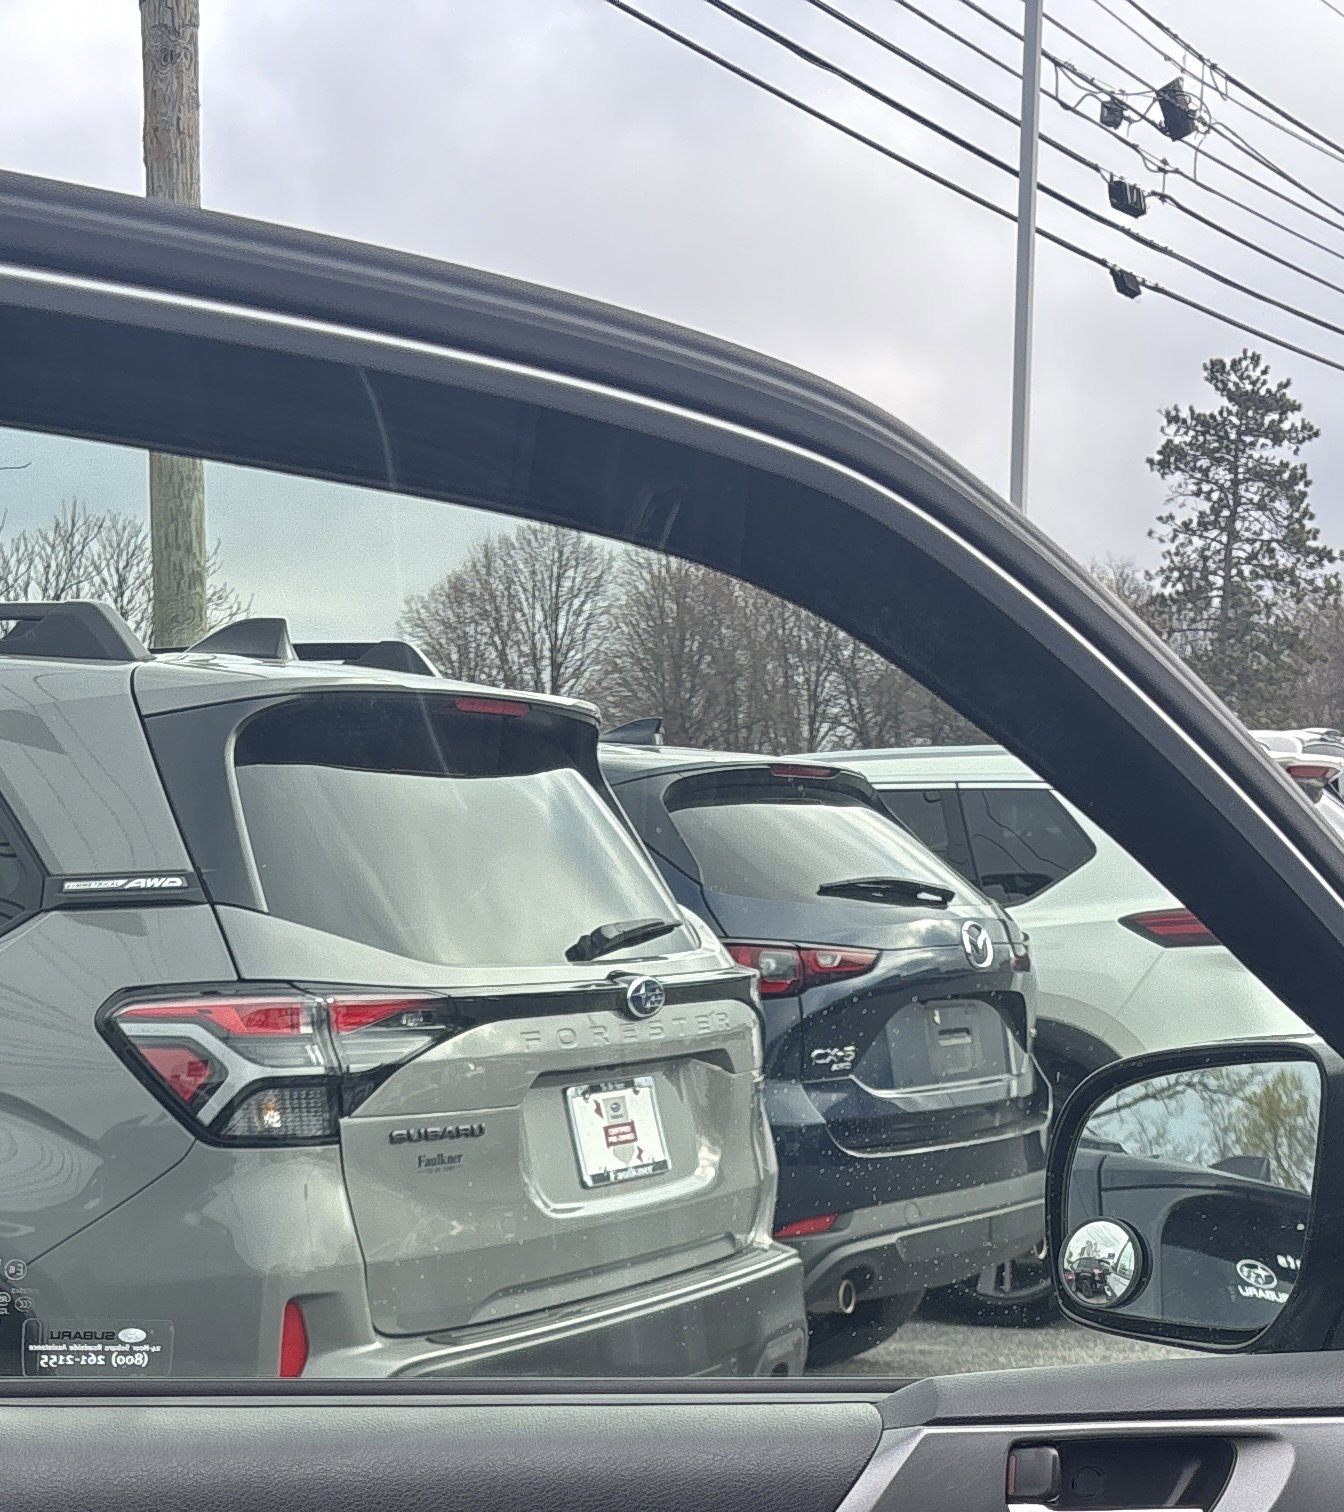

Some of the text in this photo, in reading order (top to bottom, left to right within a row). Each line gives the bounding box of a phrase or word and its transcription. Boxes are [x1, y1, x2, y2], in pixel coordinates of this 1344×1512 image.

[124, 877, 183, 889] AWD
[519, 1010, 732, 1051] FORESTER
[810, 1046, 856, 1064] CX-5
[388, 1122, 486, 1145] SUBARU
[417, 1152, 464, 1168] Faulkner
